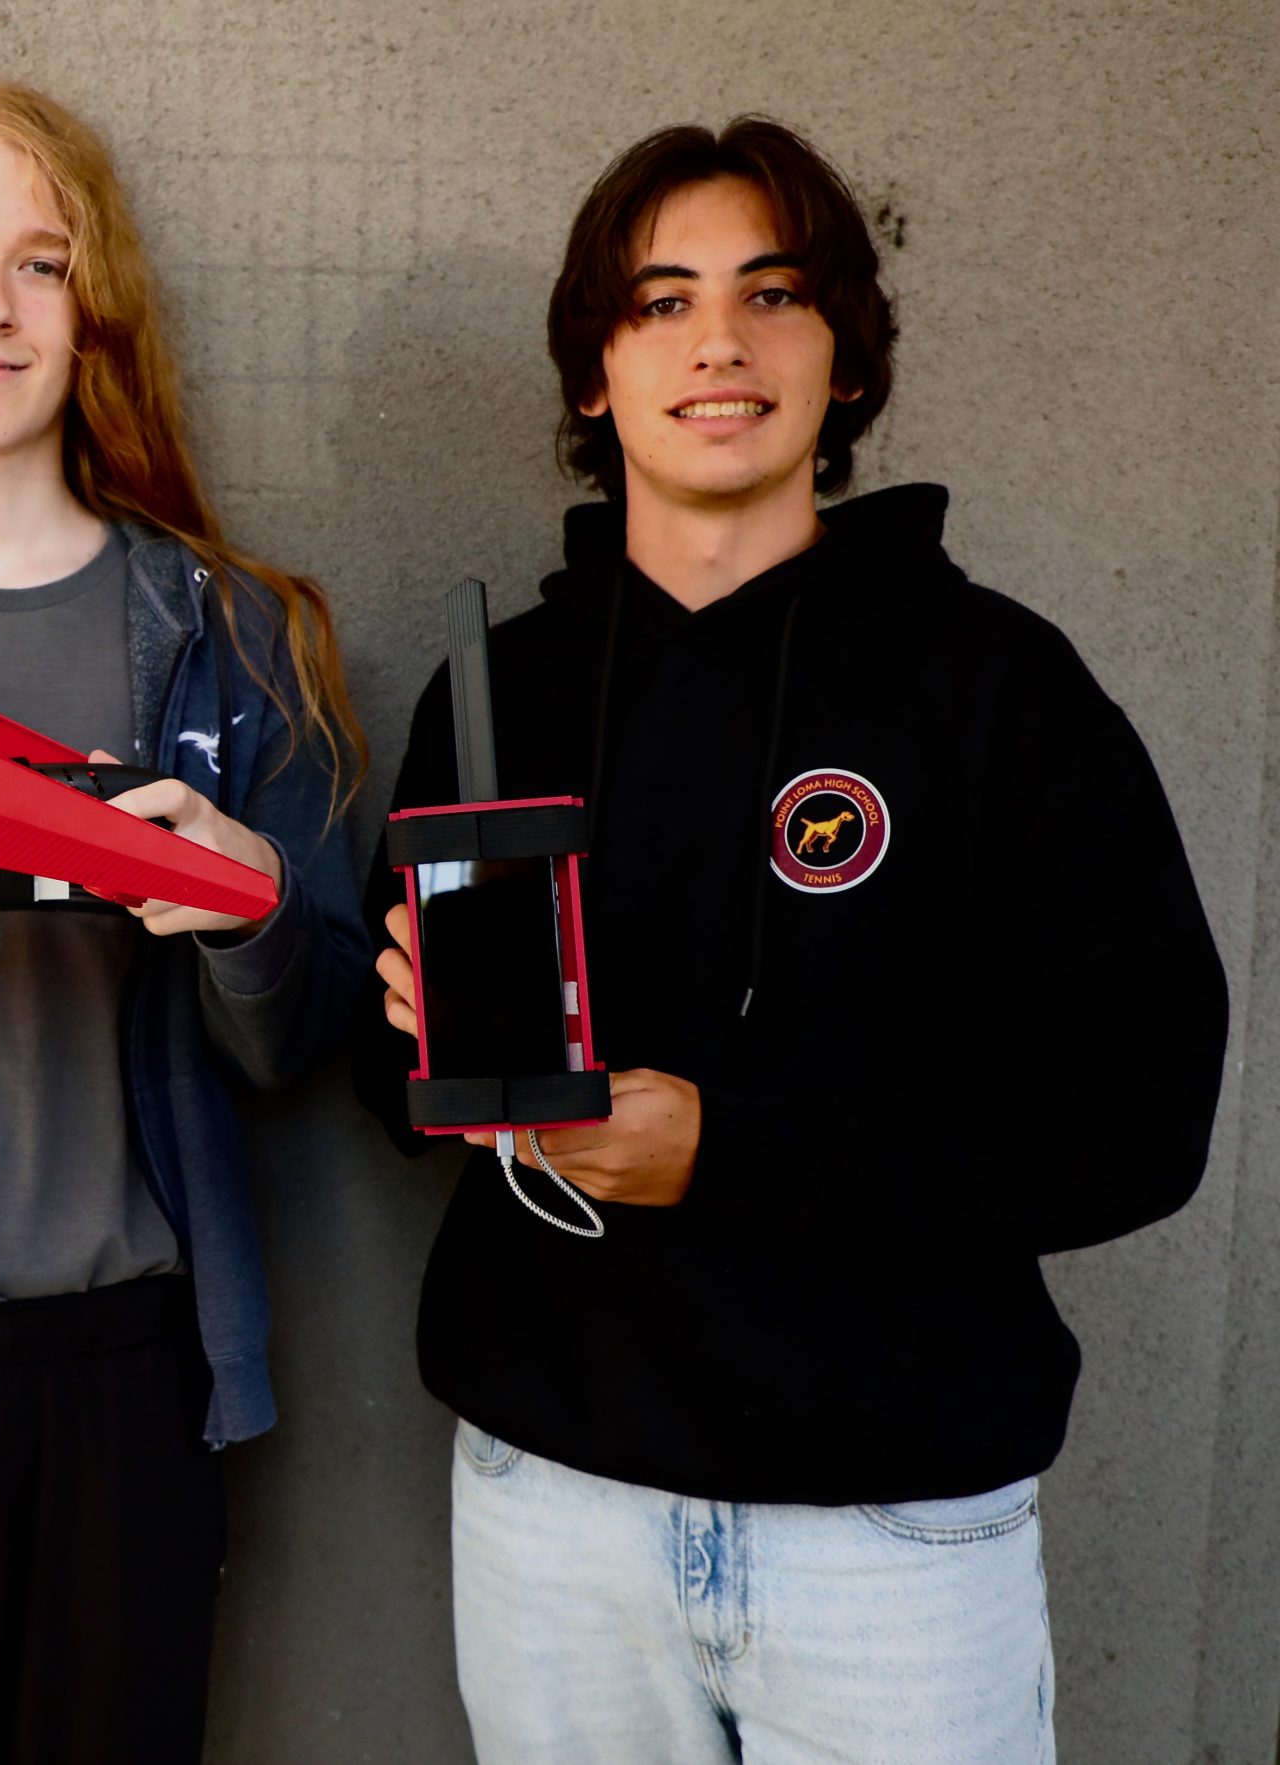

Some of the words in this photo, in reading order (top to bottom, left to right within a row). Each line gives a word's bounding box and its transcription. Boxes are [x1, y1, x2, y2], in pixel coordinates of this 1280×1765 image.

[774, 797, 794, 828] POINT
[792, 780, 822, 800] LOMA
[824, 778, 852, 791] HIGH
[851, 786, 879, 827] SCHOOL
[803, 872, 842, 884] TENNIS
